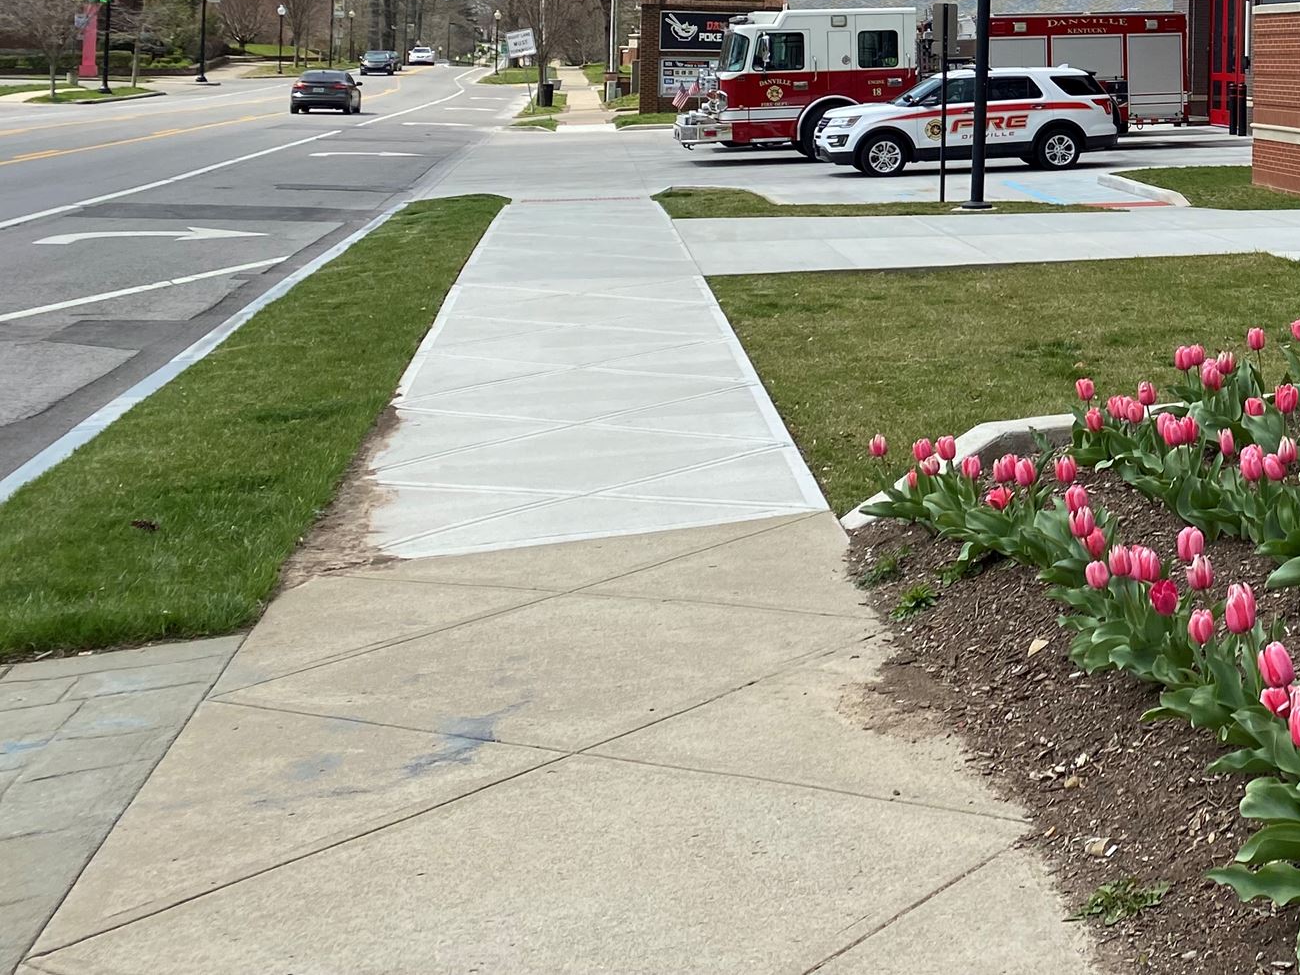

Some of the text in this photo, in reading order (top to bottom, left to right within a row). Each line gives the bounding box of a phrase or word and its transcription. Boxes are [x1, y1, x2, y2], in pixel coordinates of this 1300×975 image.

[1047, 18, 1128, 28] DANVILLE
[698, 32, 723, 42] POKE
[759, 78, 791, 86] DANVILLE
[872, 87, 882, 97] 18
[950, 114, 1029, 134] FRE
[961, 131, 1016, 140] DAVILLE
